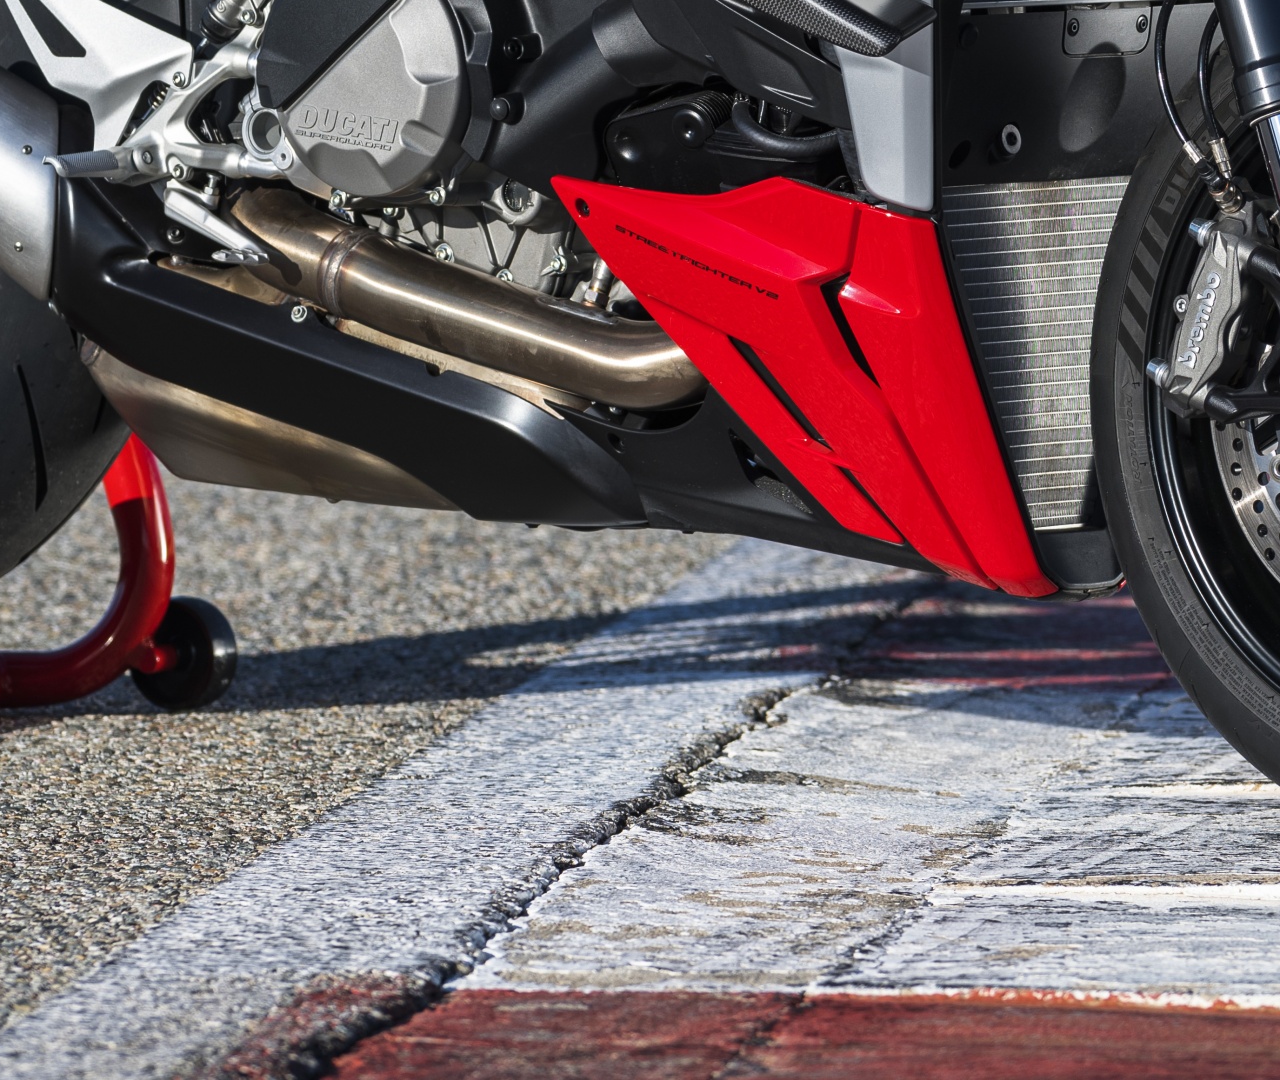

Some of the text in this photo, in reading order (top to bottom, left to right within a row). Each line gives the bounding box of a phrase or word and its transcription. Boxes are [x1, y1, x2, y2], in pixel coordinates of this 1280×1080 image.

[294, 128, 393, 152] SUPERQUADRO
[298, 104, 399, 145] DUCATI
[614, 223, 780, 301] STREETFIGHTER V2
[1176, 270, 1222, 370] brembo
